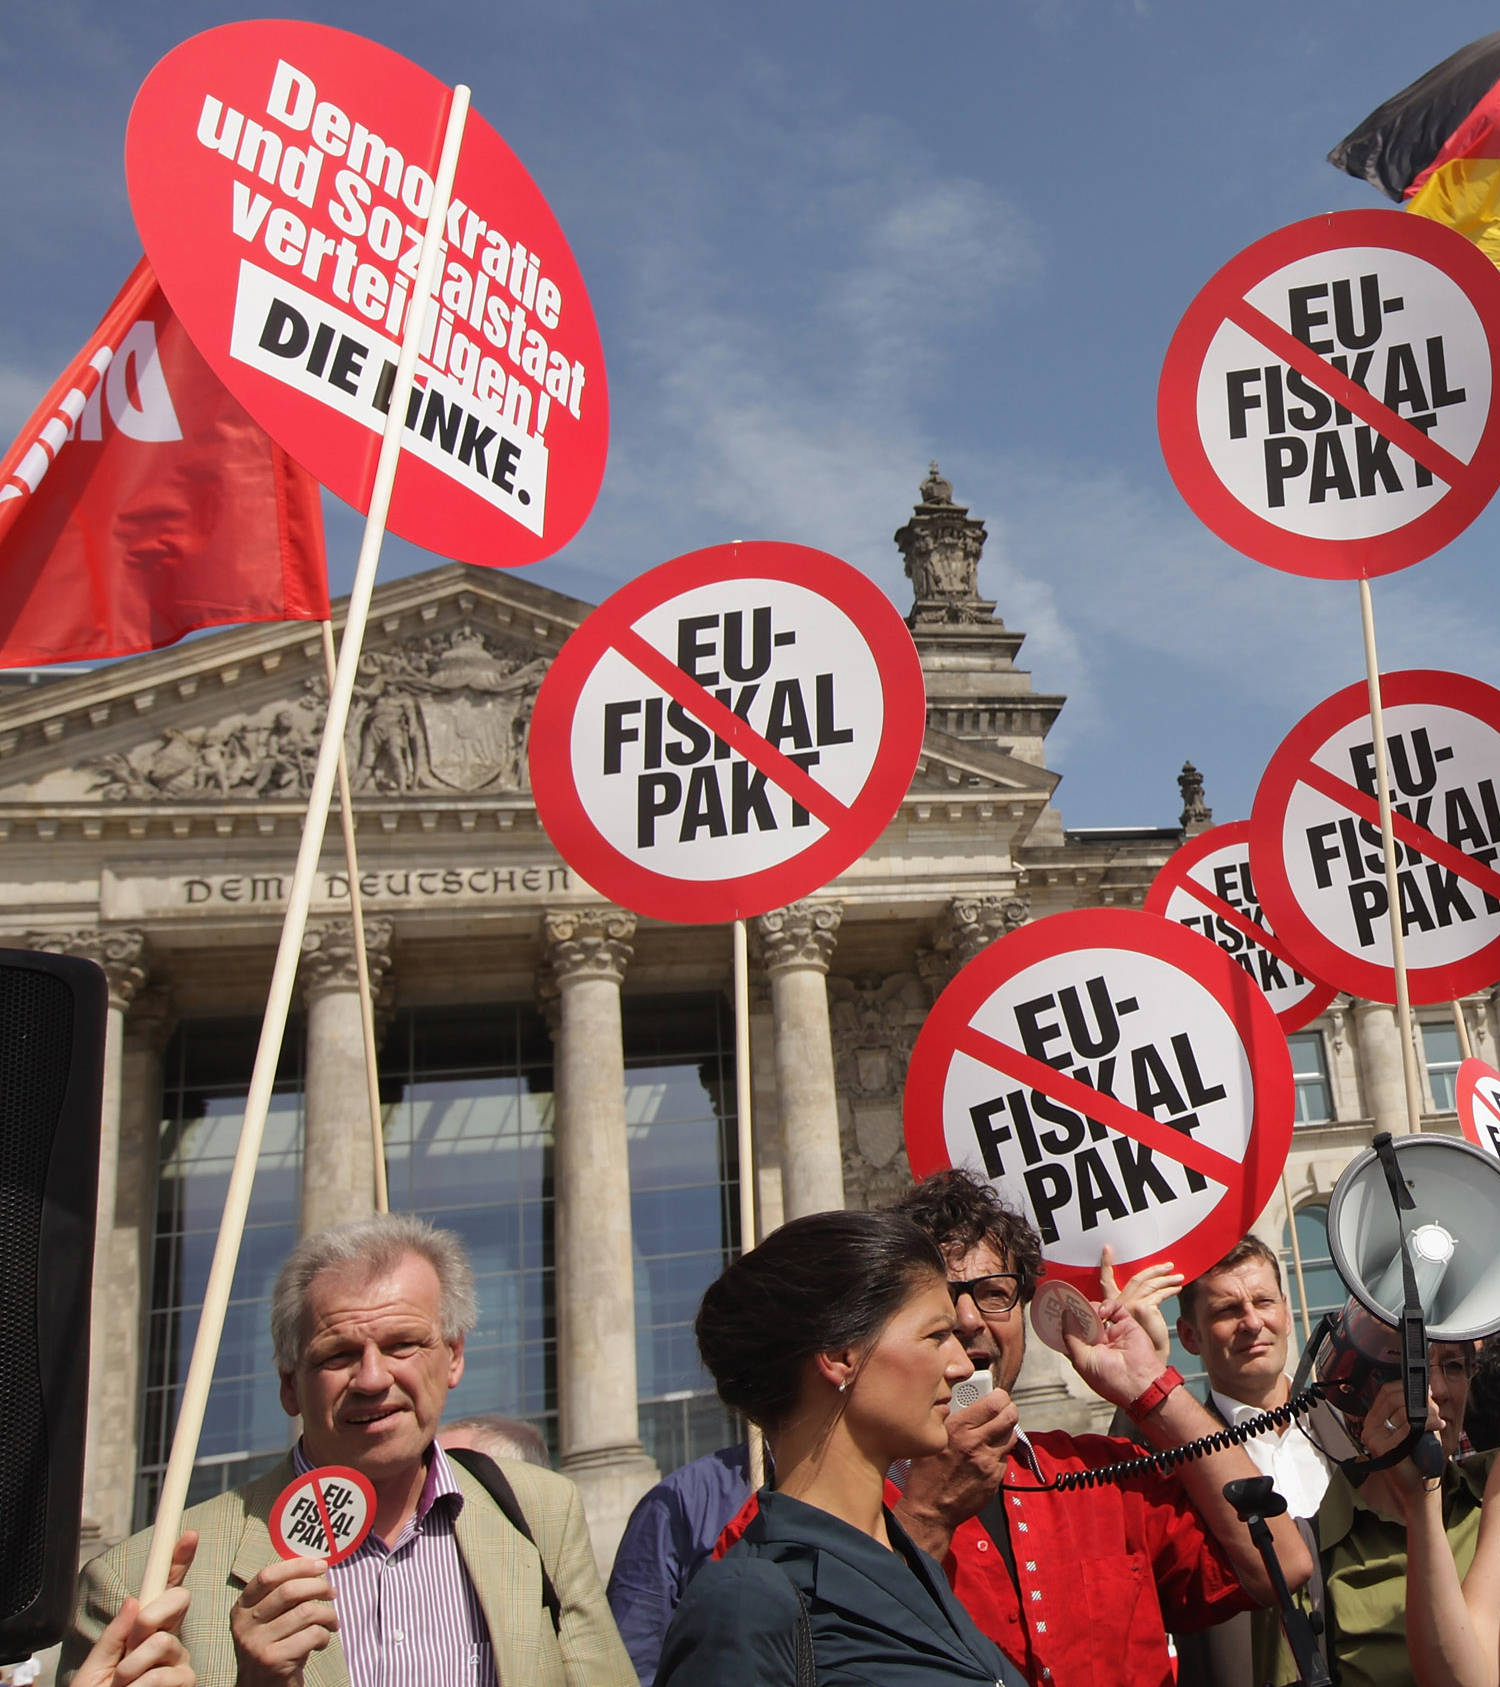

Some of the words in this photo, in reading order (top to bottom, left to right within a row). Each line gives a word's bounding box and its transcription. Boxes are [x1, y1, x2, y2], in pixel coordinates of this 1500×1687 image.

[196, 93, 325, 209] und
[258, 297, 369, 397] DIE
[1288, 273, 1404, 355] EU-
[1226, 335, 1467, 440] FISKAL
[1264, 412, 1438, 508] PAKT
[677, 606, 796, 688] EU-
[603, 673, 854, 775] FISKAL
[1349, 727, 1454, 802] EU-
[637, 751, 820, 848] PAKT
[183, 876, 284, 904] DEM
[326, 867, 571, 900] DEUTSCHEN
[1013, 975, 1140, 1070] EU-
[969, 1032, 1228, 1180] FISKAL
[1023, 1113, 1208, 1246] PAKT
[290, 1497, 355, 1537] FISKAL
[322, 1483, 354, 1510] EU-
